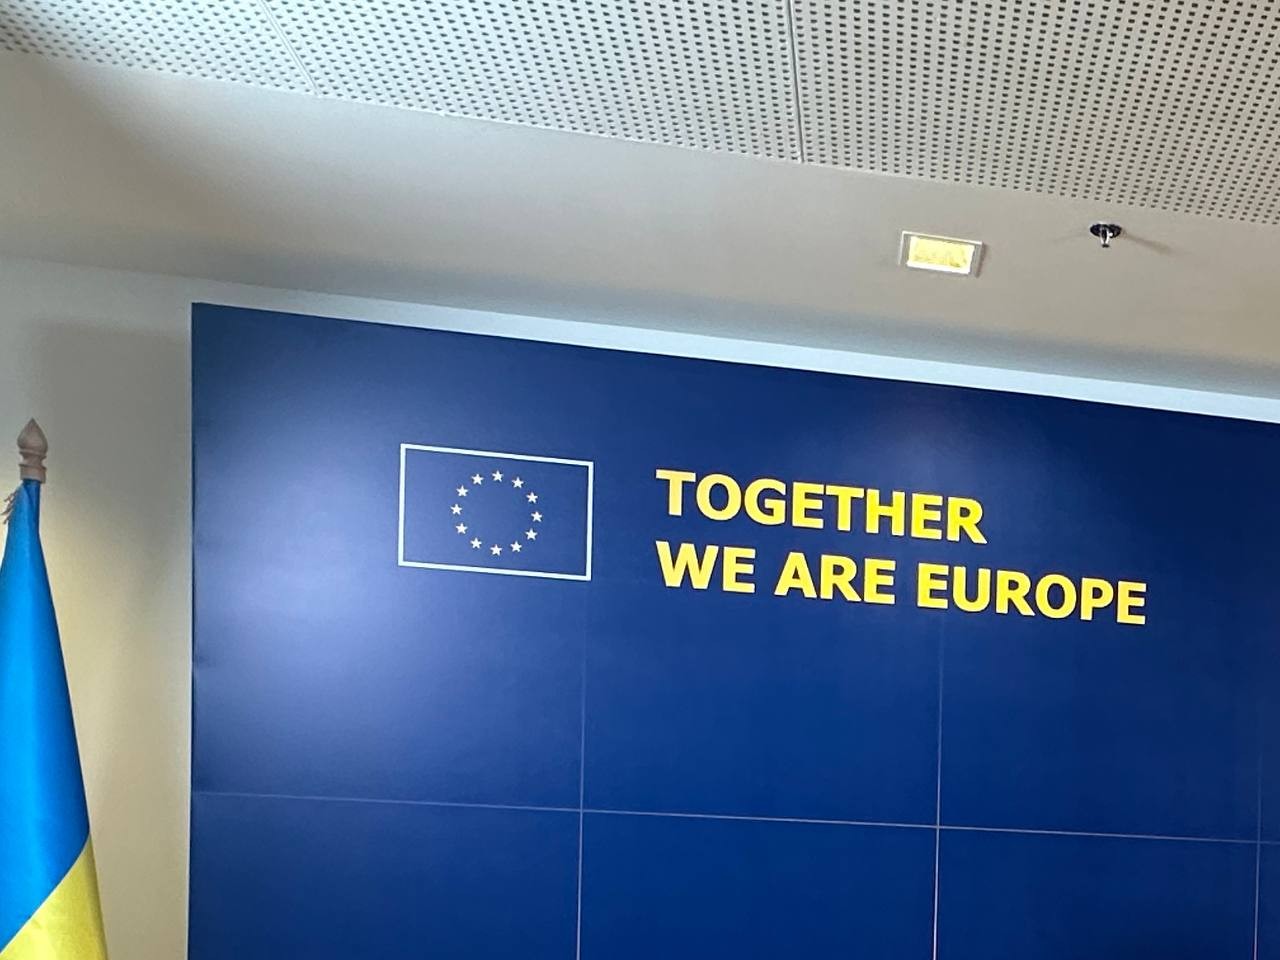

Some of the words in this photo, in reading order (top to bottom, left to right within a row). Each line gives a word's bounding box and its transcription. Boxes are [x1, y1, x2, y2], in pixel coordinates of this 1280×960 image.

[654, 468, 988, 545] TOGETHER
[655, 541, 757, 594] WE
[774, 552, 898, 606] ARE
[915, 563, 1147, 626] EUROPE
